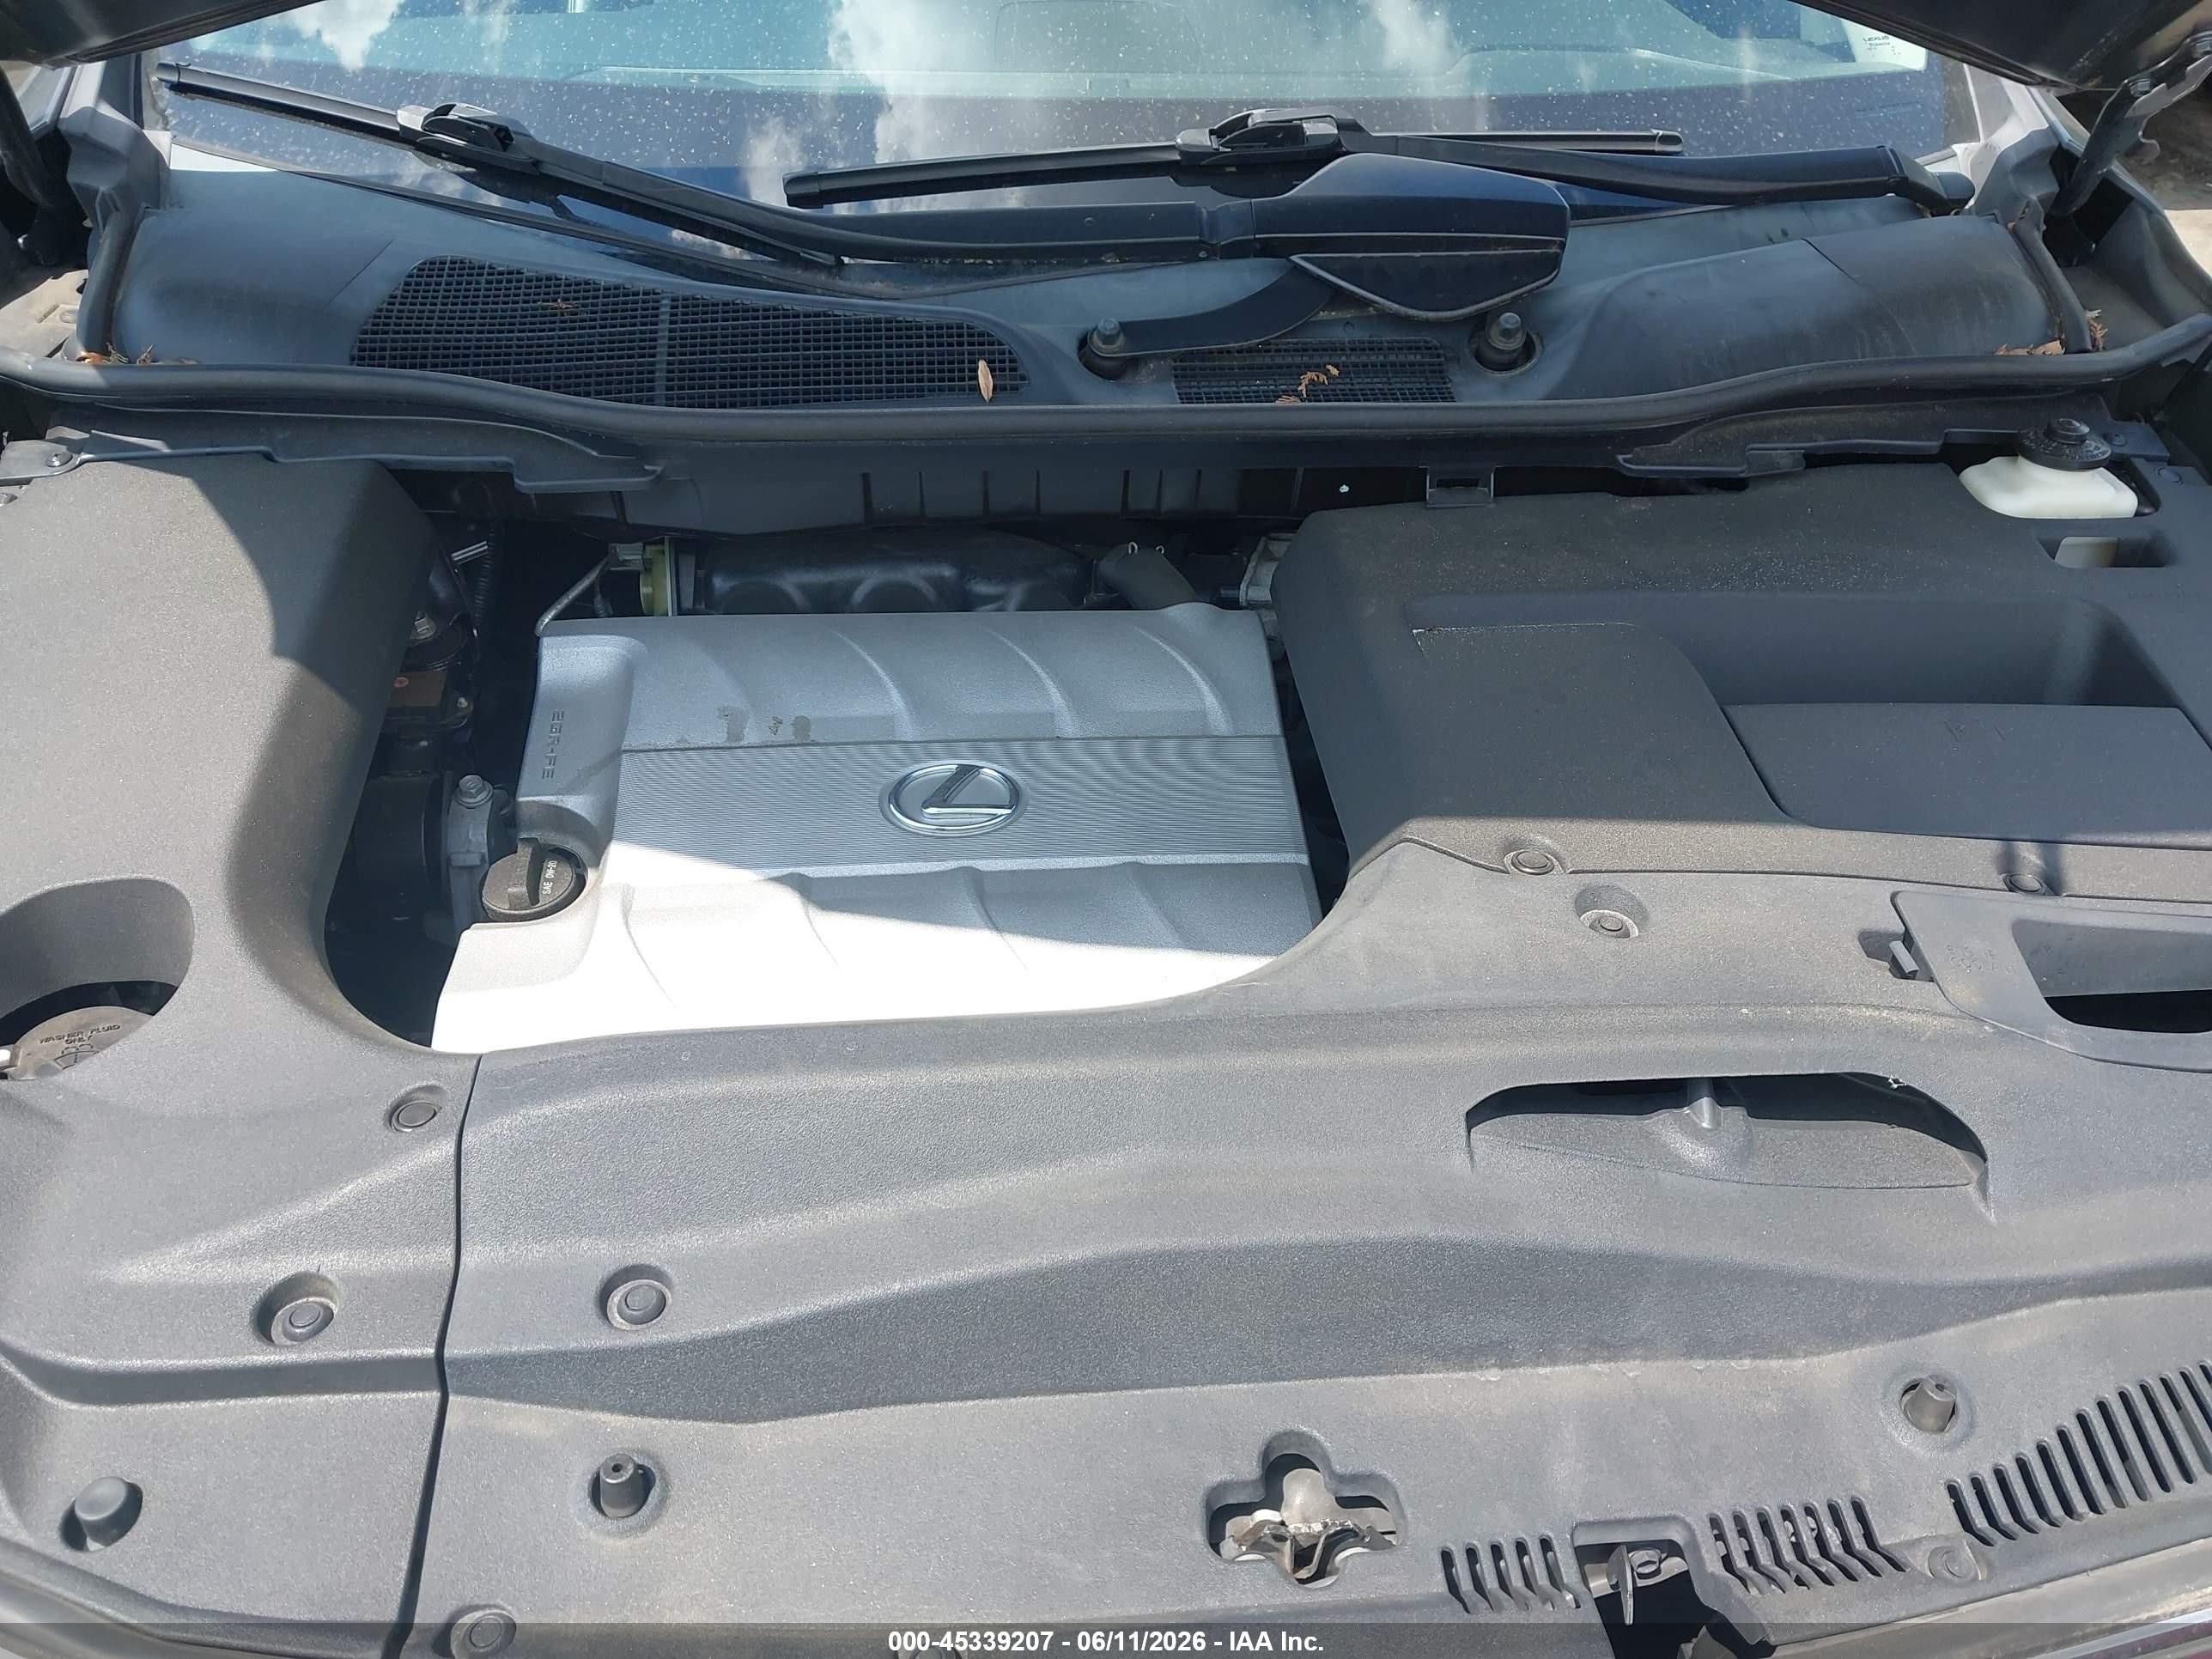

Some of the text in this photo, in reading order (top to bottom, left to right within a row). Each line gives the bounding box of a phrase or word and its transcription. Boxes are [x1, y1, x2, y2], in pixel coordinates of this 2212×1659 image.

[542, 710, 565, 780] 2GR-FE
[542, 860, 557, 895] SAE 0W-20
[39, 1024, 120, 1044] WASHER FLUID
[65, 1035, 93, 1045] ONLY
